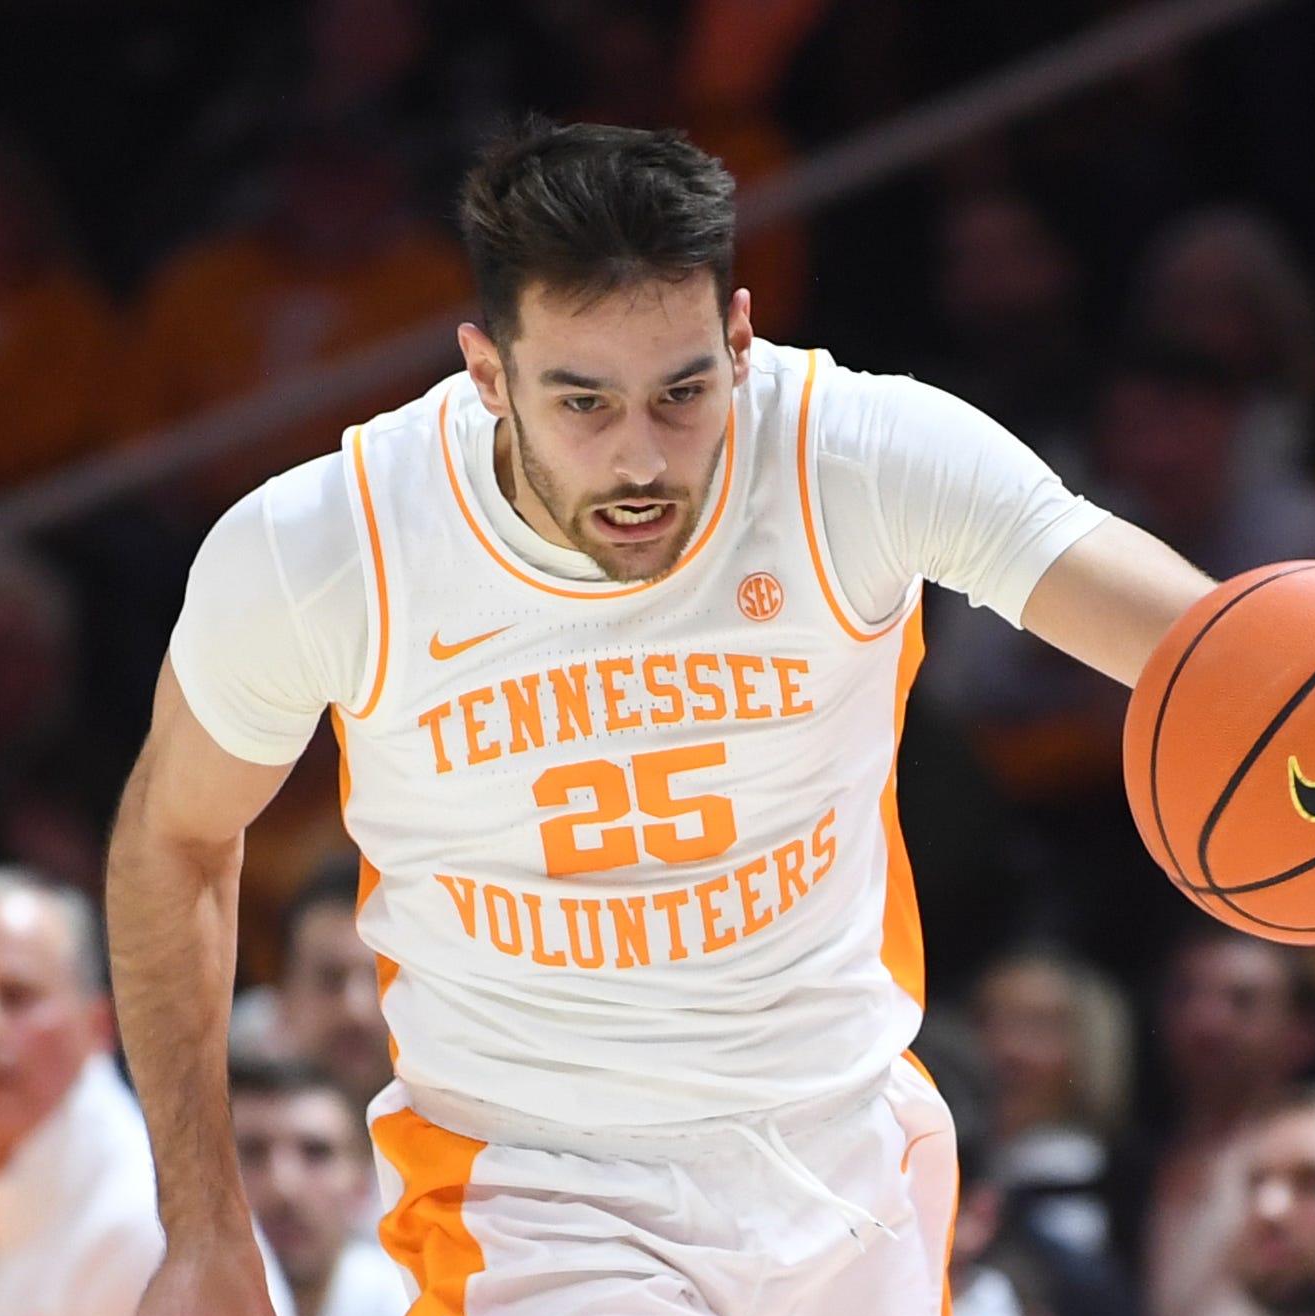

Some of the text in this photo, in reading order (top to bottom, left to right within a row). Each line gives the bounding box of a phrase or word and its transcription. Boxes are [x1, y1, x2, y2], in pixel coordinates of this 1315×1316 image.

[740, 575, 781, 619] SEC
[418, 653, 814, 774] TENNESSEE
[531, 741, 738, 878] 25
[434, 807, 837, 970] VOLUNTEERS
